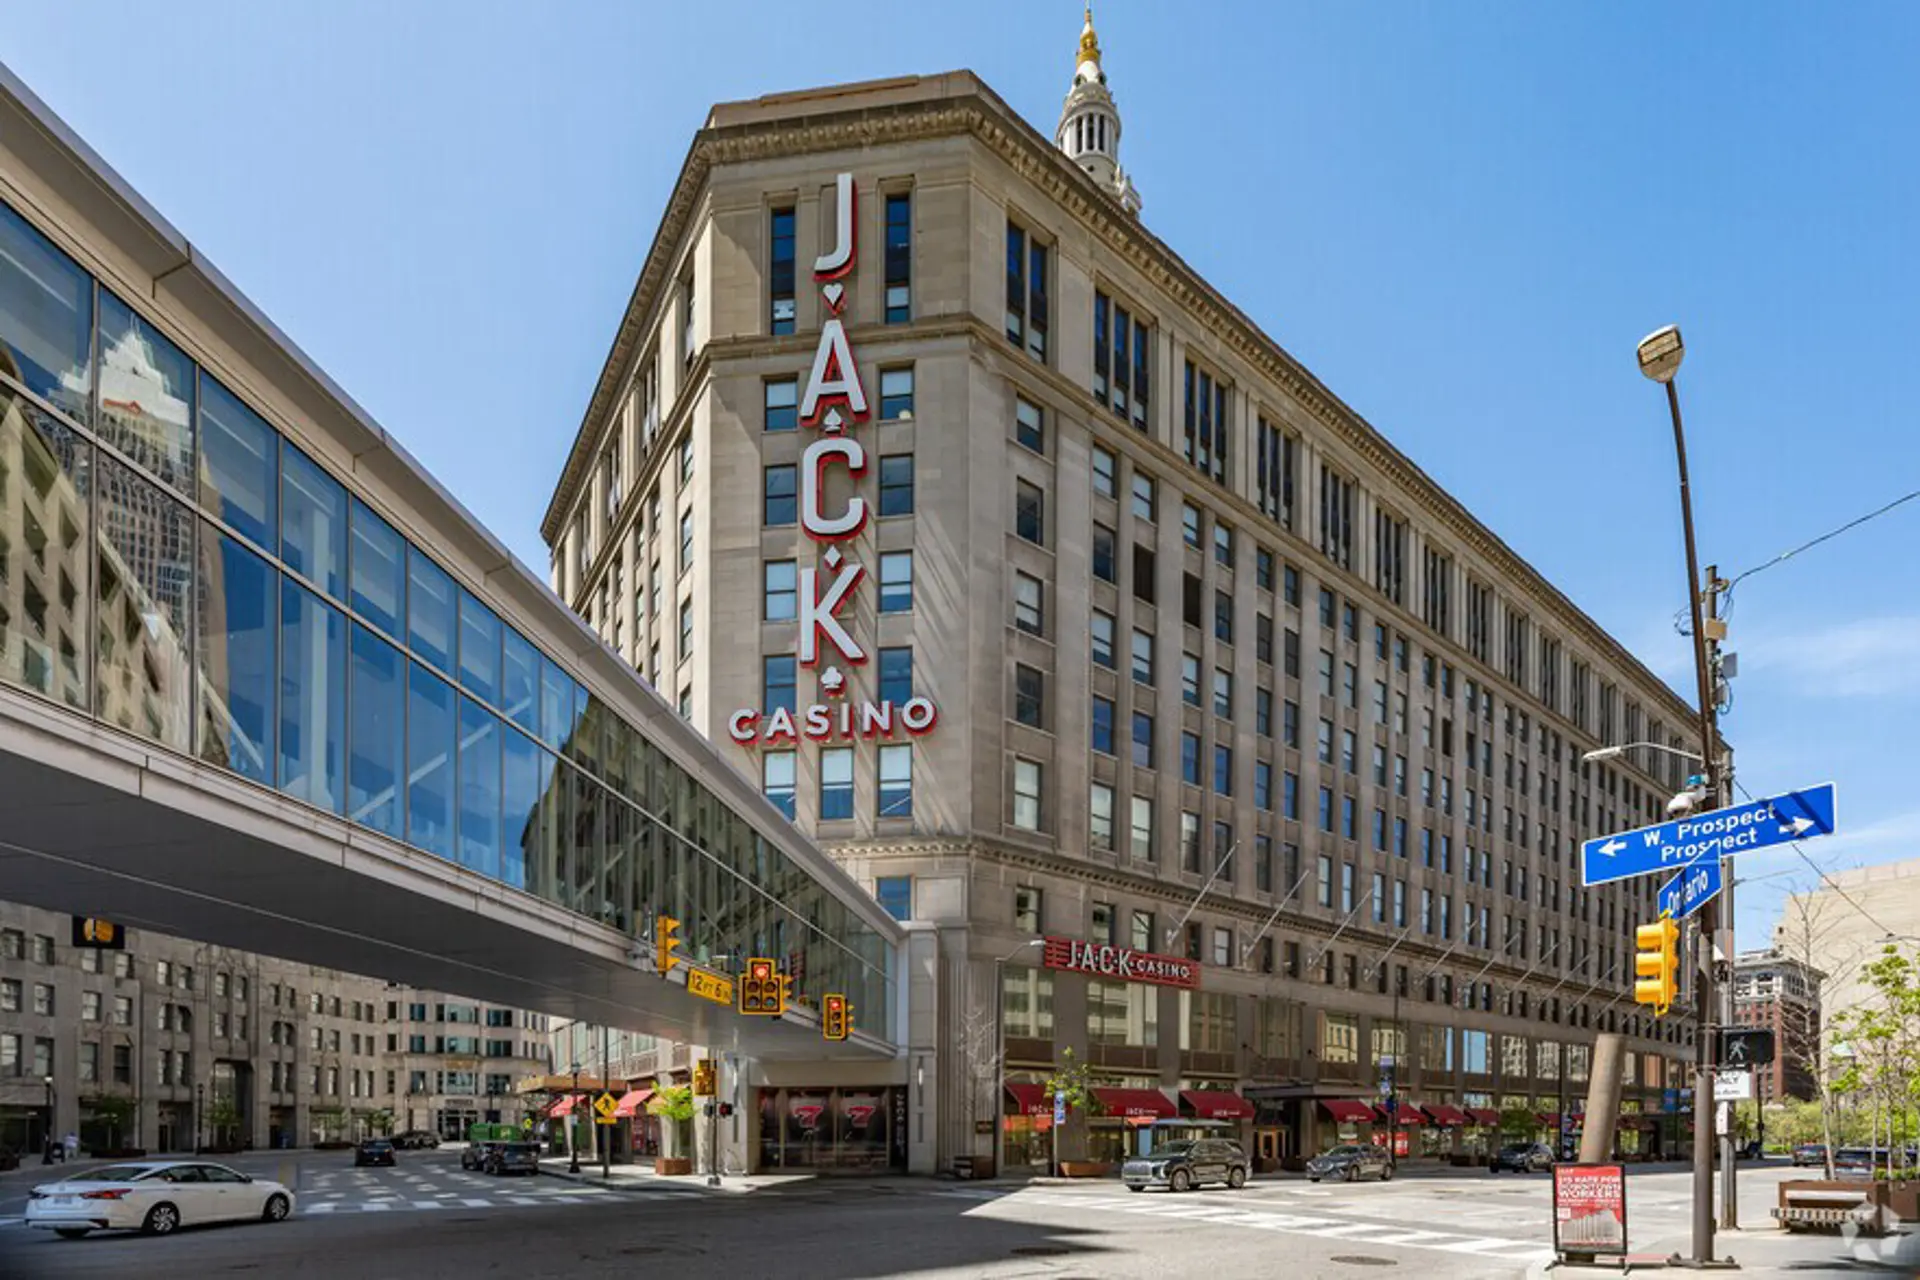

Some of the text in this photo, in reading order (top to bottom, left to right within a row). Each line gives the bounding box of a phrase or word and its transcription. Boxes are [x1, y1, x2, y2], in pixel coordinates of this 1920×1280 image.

[729, 697, 936, 741] CASINO
[1643, 802, 1776, 848] W. Prospect
[1667, 867, 1709, 917] Ontario
[692, 972, 704, 991] 12
[714, 982, 722, 998] 6
[1136, 958, 1191, 978] CASINO
